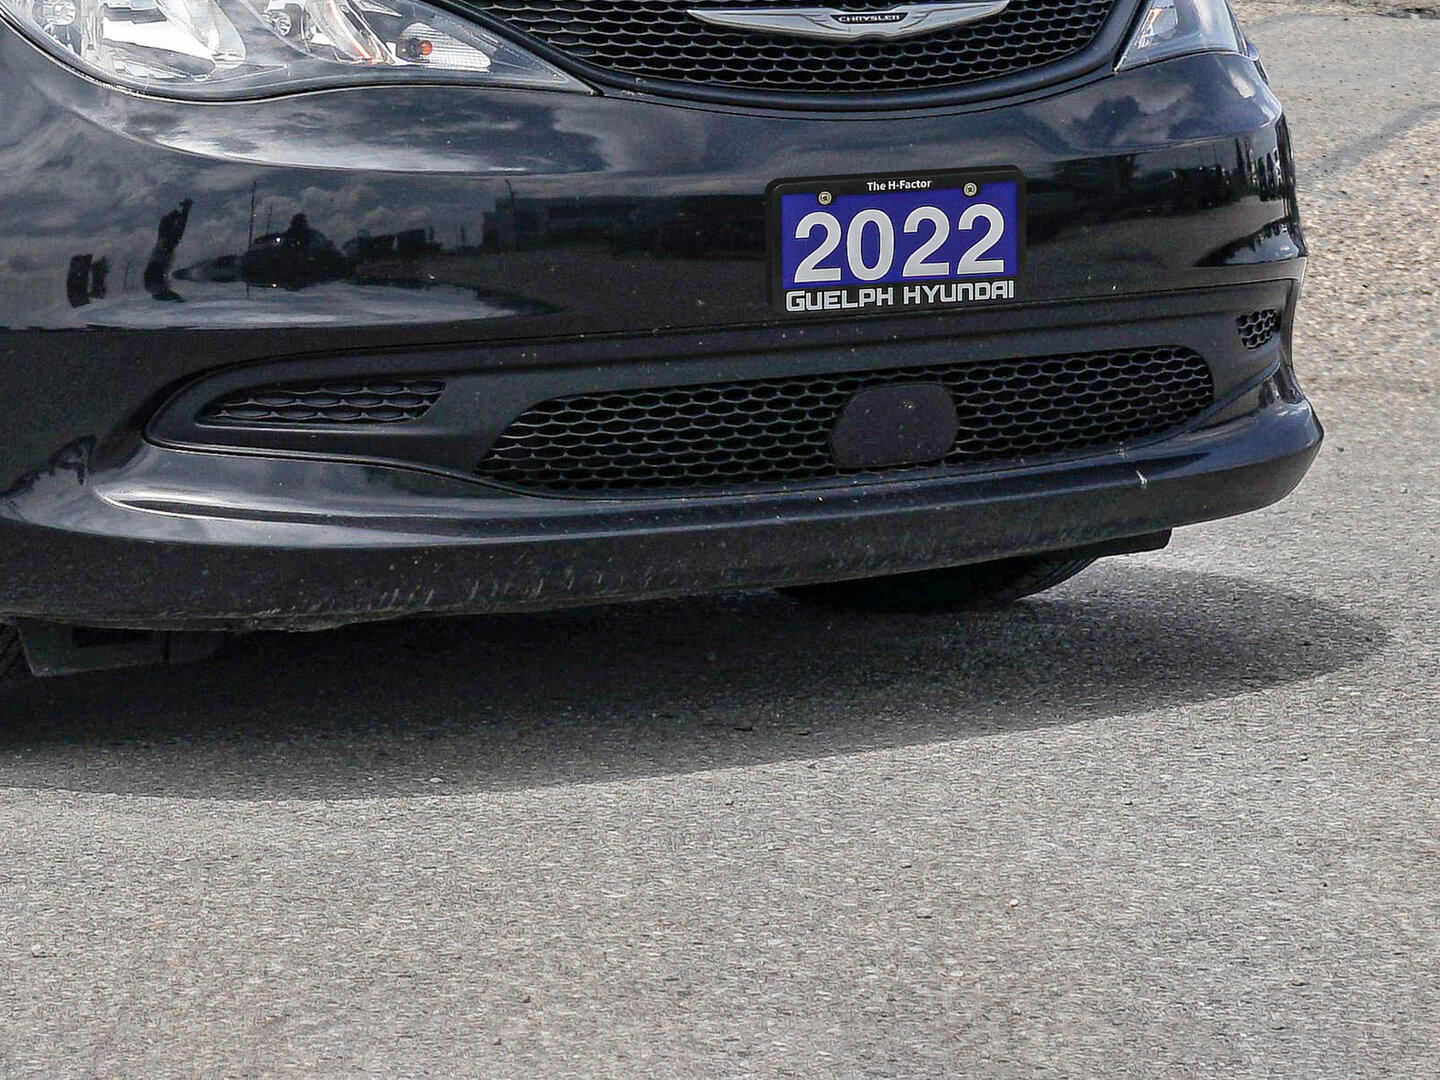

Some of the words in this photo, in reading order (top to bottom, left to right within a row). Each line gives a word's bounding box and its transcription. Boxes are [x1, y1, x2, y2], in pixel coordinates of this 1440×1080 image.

[838, 14, 900, 22] CHRYSLER
[867, 181, 886, 192] The
[888, 180, 932, 190] H-Factor
[794, 203, 1005, 283] 2022
[786, 287, 894, 312] GUELPH
[902, 280, 1015, 305] HYUNDAI
